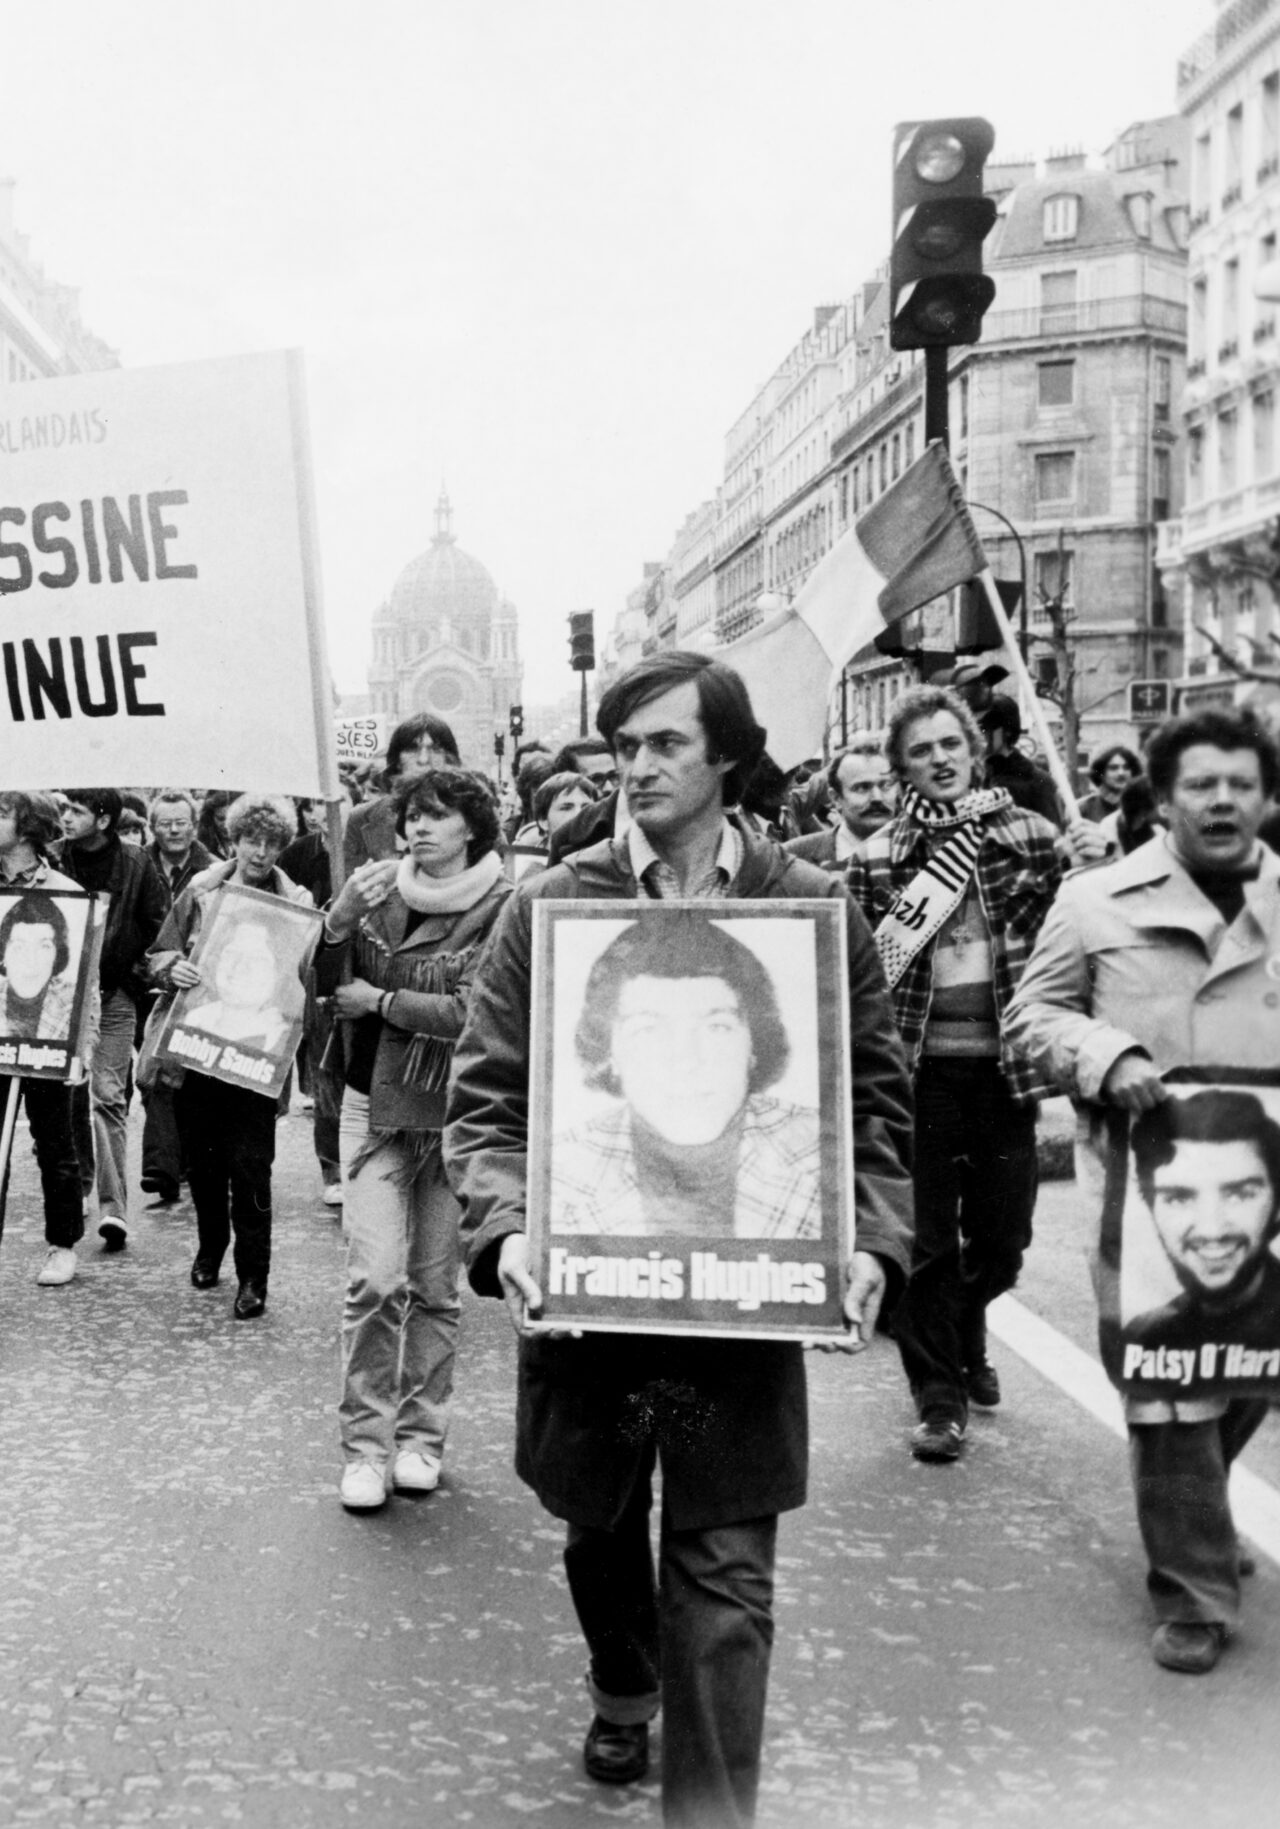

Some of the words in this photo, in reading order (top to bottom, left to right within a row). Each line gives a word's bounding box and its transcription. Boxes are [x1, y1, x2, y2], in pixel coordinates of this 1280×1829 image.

[17, 1043, 68, 1070] Hughes
[167, 1028, 222, 1069] Bobby
[218, 1045, 276, 1084] Sands
[548, 1248, 684, 1300] Francis
[690, 1251, 826, 1311] Hughes
[1122, 1343, 1197, 1386] Patsy
